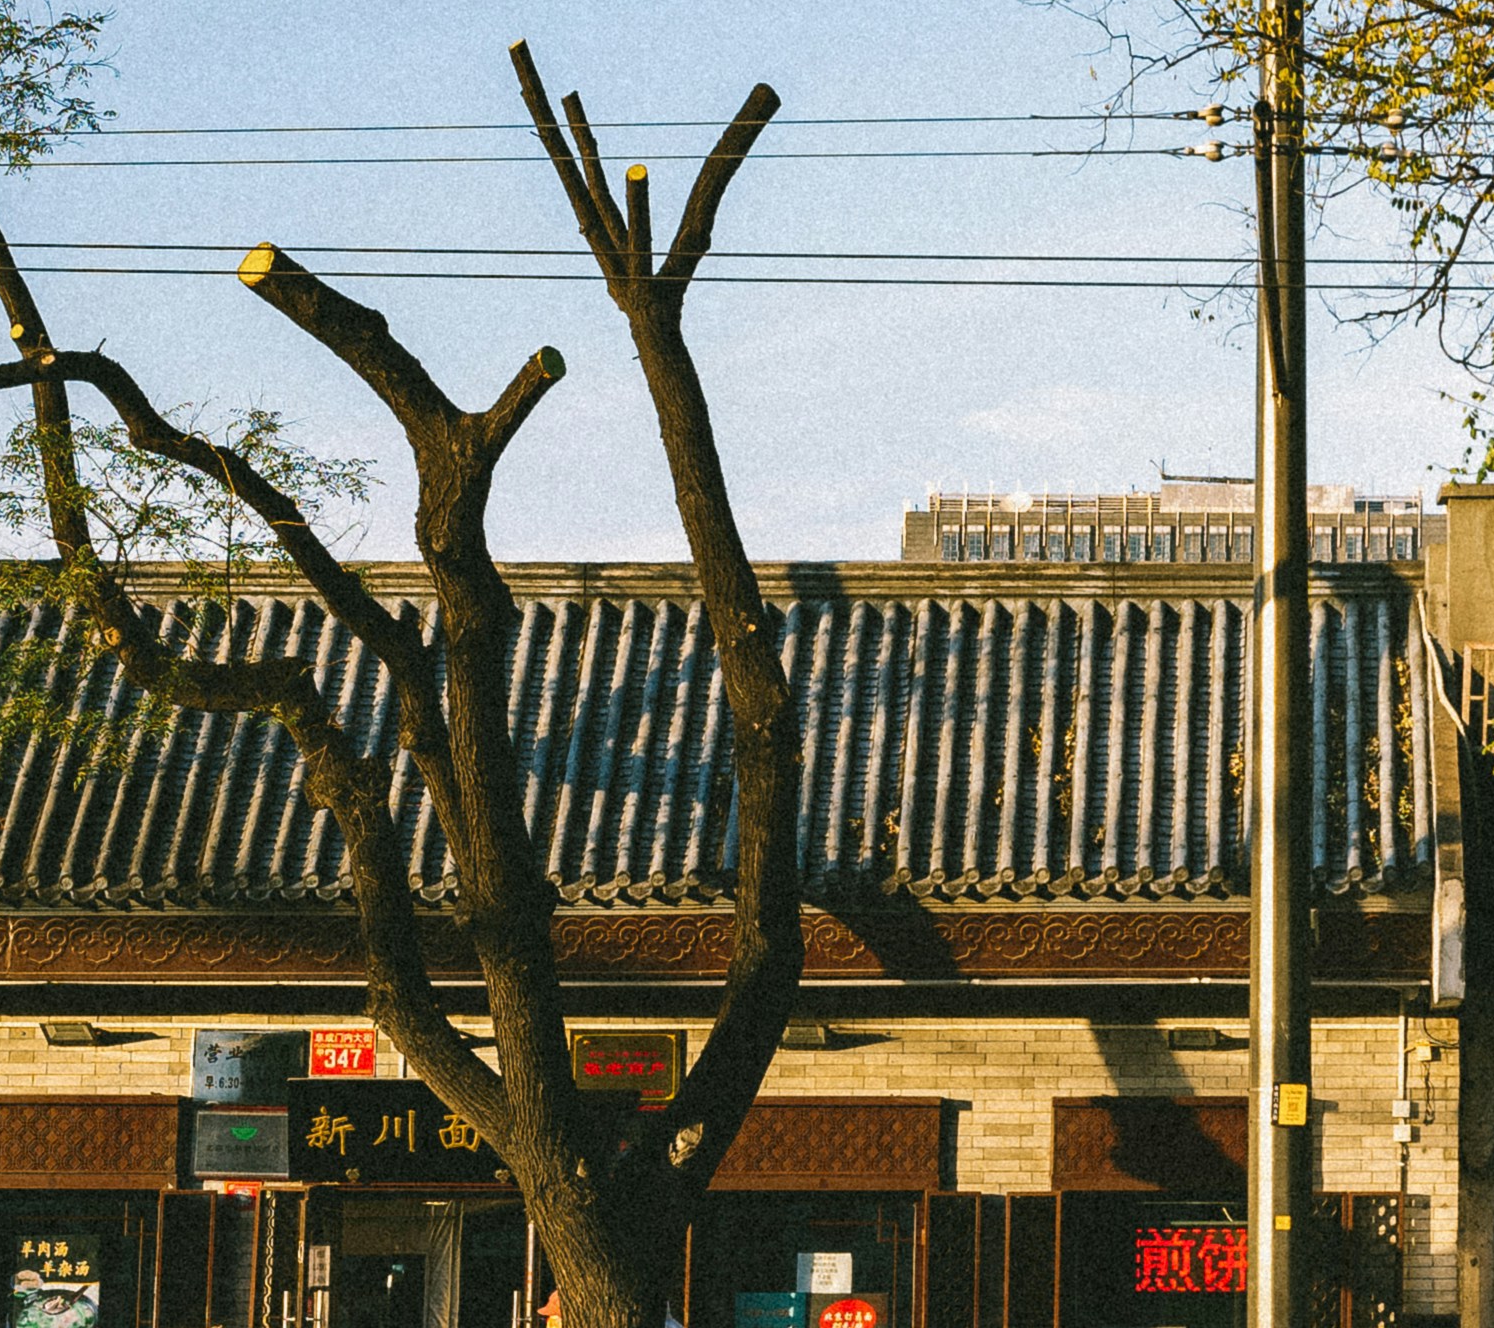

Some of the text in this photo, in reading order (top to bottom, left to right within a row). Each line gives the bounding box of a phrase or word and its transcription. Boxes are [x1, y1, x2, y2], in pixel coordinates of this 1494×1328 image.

[324, 1049, 363, 1068] 347
[20, 1240, 70, 1259] 羊肉汤
[39, 1260, 91, 1278] 羊杂汤
[1140, 1231, 1248, 1292] 煎饼
